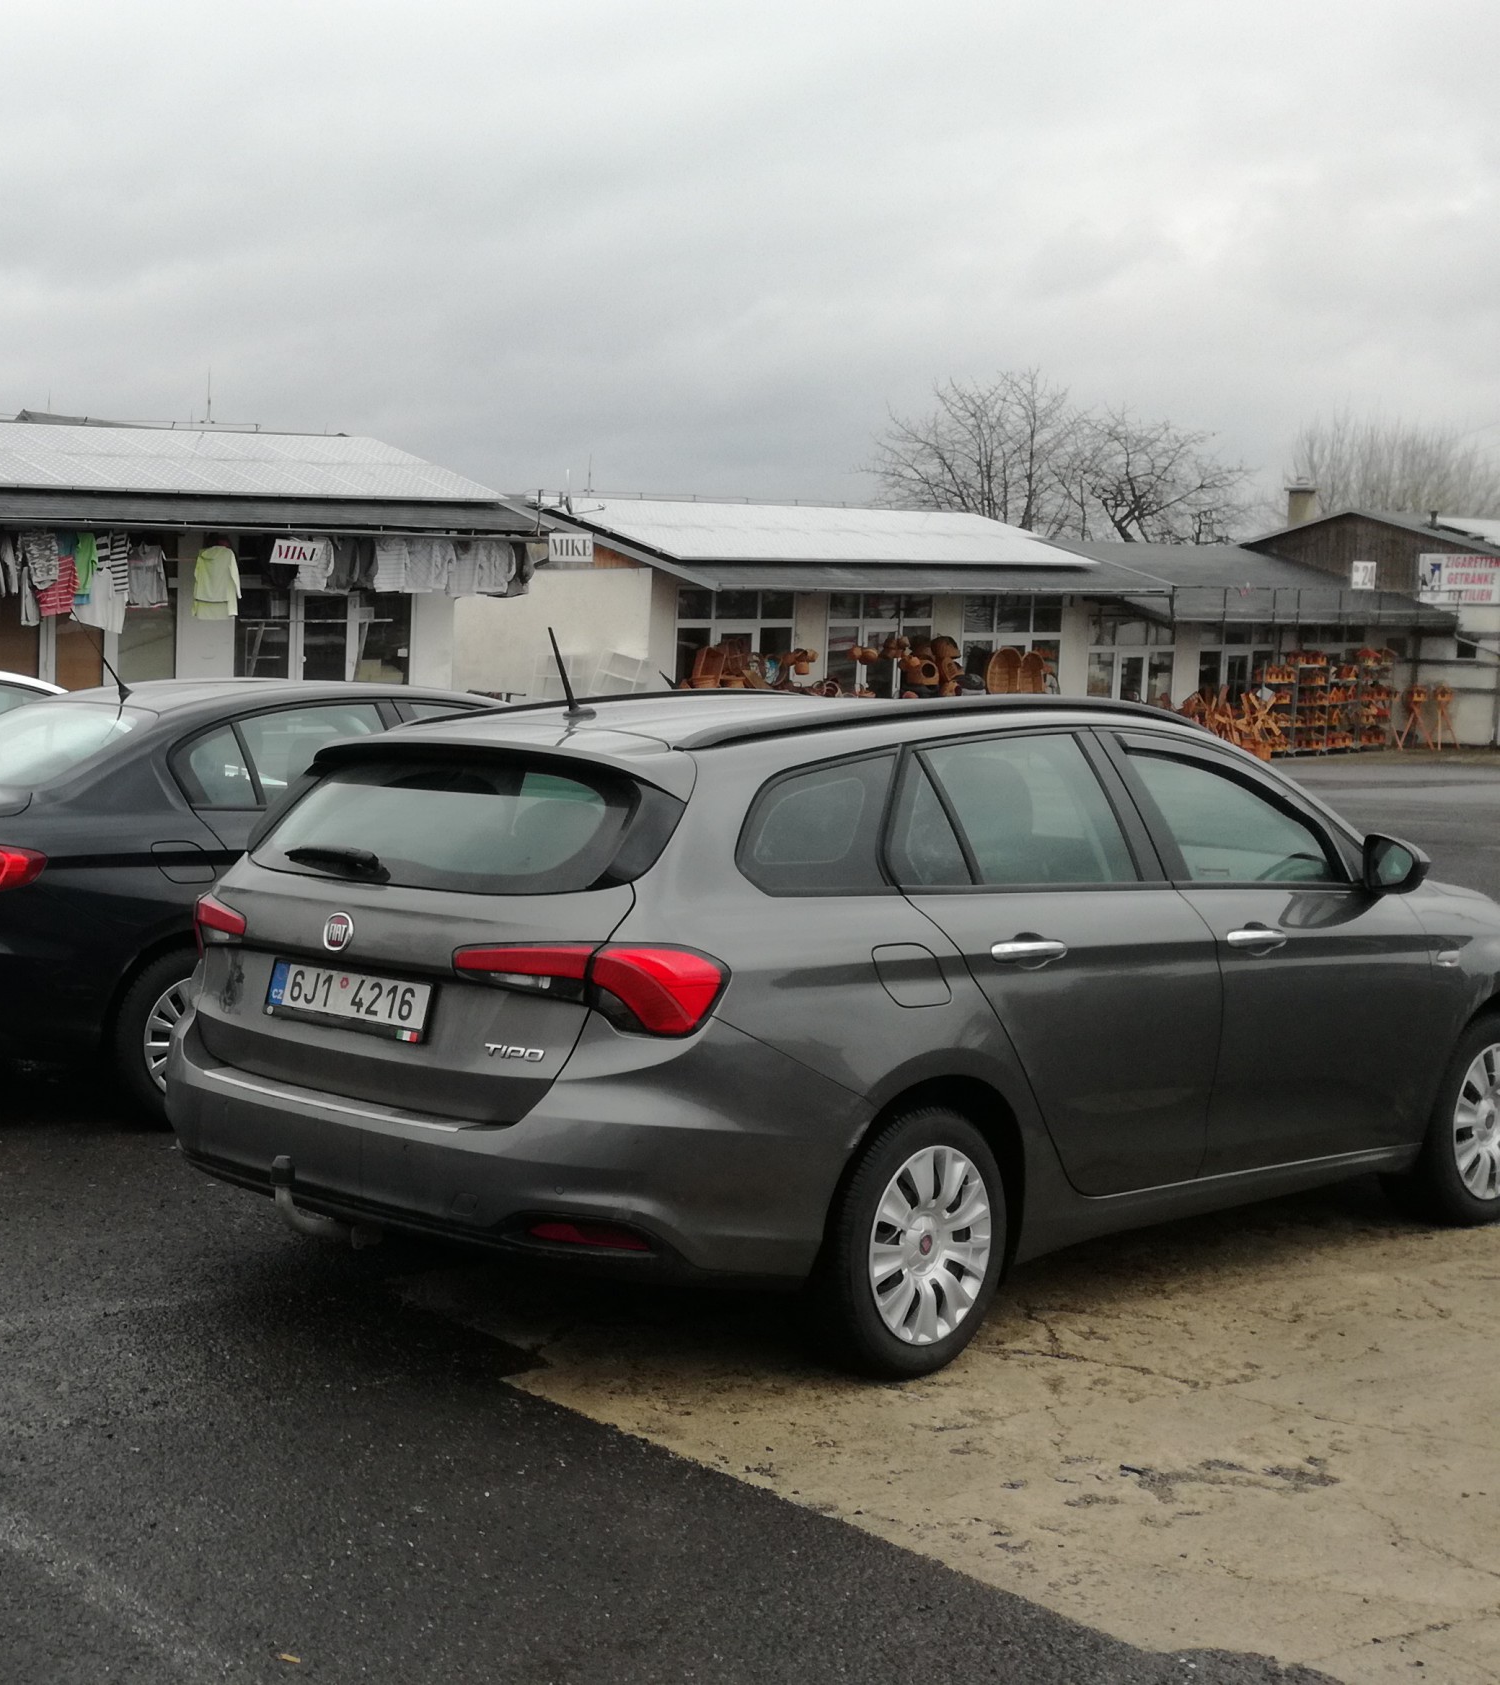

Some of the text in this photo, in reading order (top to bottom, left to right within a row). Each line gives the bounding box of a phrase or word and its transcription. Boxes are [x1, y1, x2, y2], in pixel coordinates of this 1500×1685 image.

[277, 544, 319, 562] MIKE
[551, 538, 592, 557] MIKE
[329, 923, 347, 942] FIAT
[271, 988, 284, 1000] CZ
[290, 970, 416, 1021] 6J1 4216
[484, 1042, 546, 1062] TIPO
